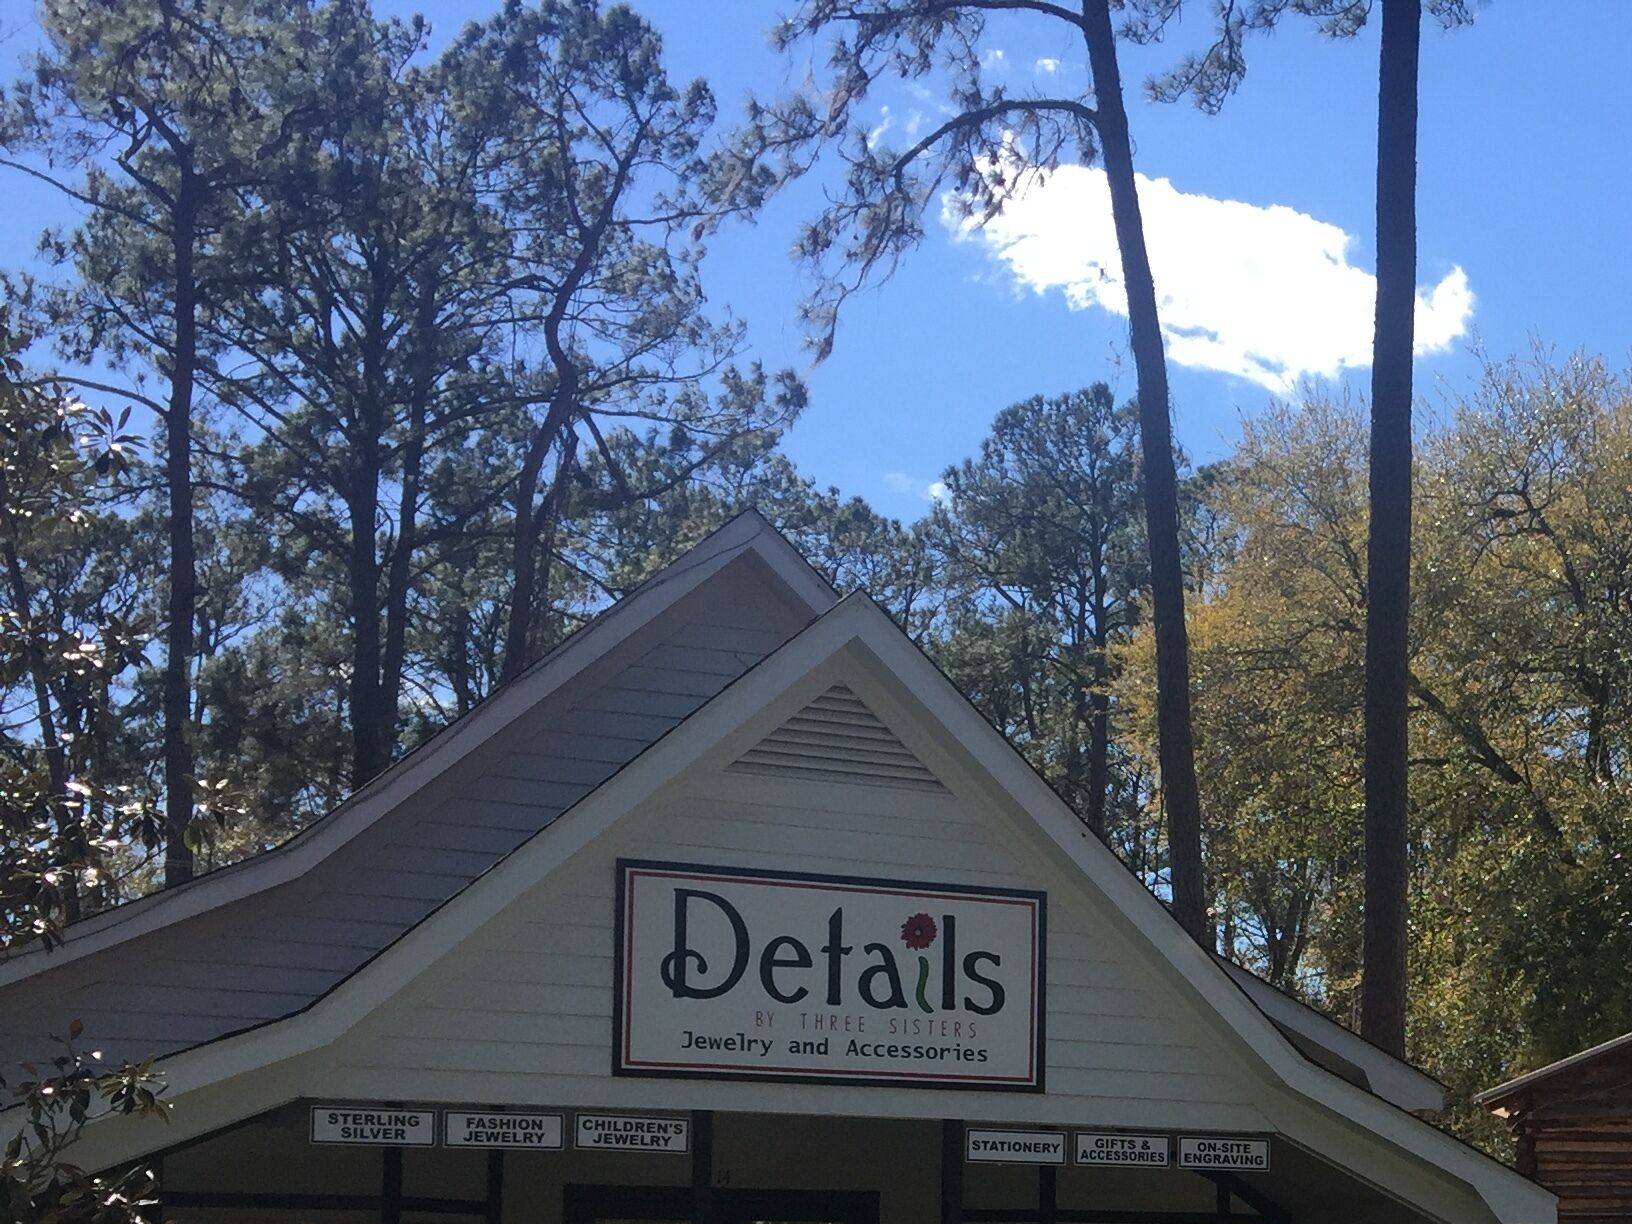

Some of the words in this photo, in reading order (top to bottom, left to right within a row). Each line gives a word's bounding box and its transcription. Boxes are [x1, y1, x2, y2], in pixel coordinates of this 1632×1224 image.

[660, 888, 1006, 1016] Details
[755, 1010, 775, 1028] BY
[801, 1013, 865, 1034] THREE
[889, 1017, 978, 1039] SISTERS
[681, 1030, 774, 1057] Jewelry
[788, 1037, 829, 1056] and
[846, 1039, 988, 1063] Accessories
[327, 1112, 420, 1128] STERLING
[465, 1116, 543, 1131] FASHION
[582, 1119, 683, 1135] CHILDREN'S
[340, 1126, 406, 1140] SILVER
[463, 1130, 545, 1145] JEWELRY
[592, 1133, 672, 1147] JEWELRY
[971, 1139, 1061, 1154] STATIONERY
[1094, 1138, 1136, 1151] GIFTS
[1137, 1140, 1151, 1151] &
[1197, 1142, 1251, 1154] ON-SITE
[1080, 1150, 1165, 1163] ACCESSORIES
[1184, 1153, 1264, 1166] ENGRAVING
